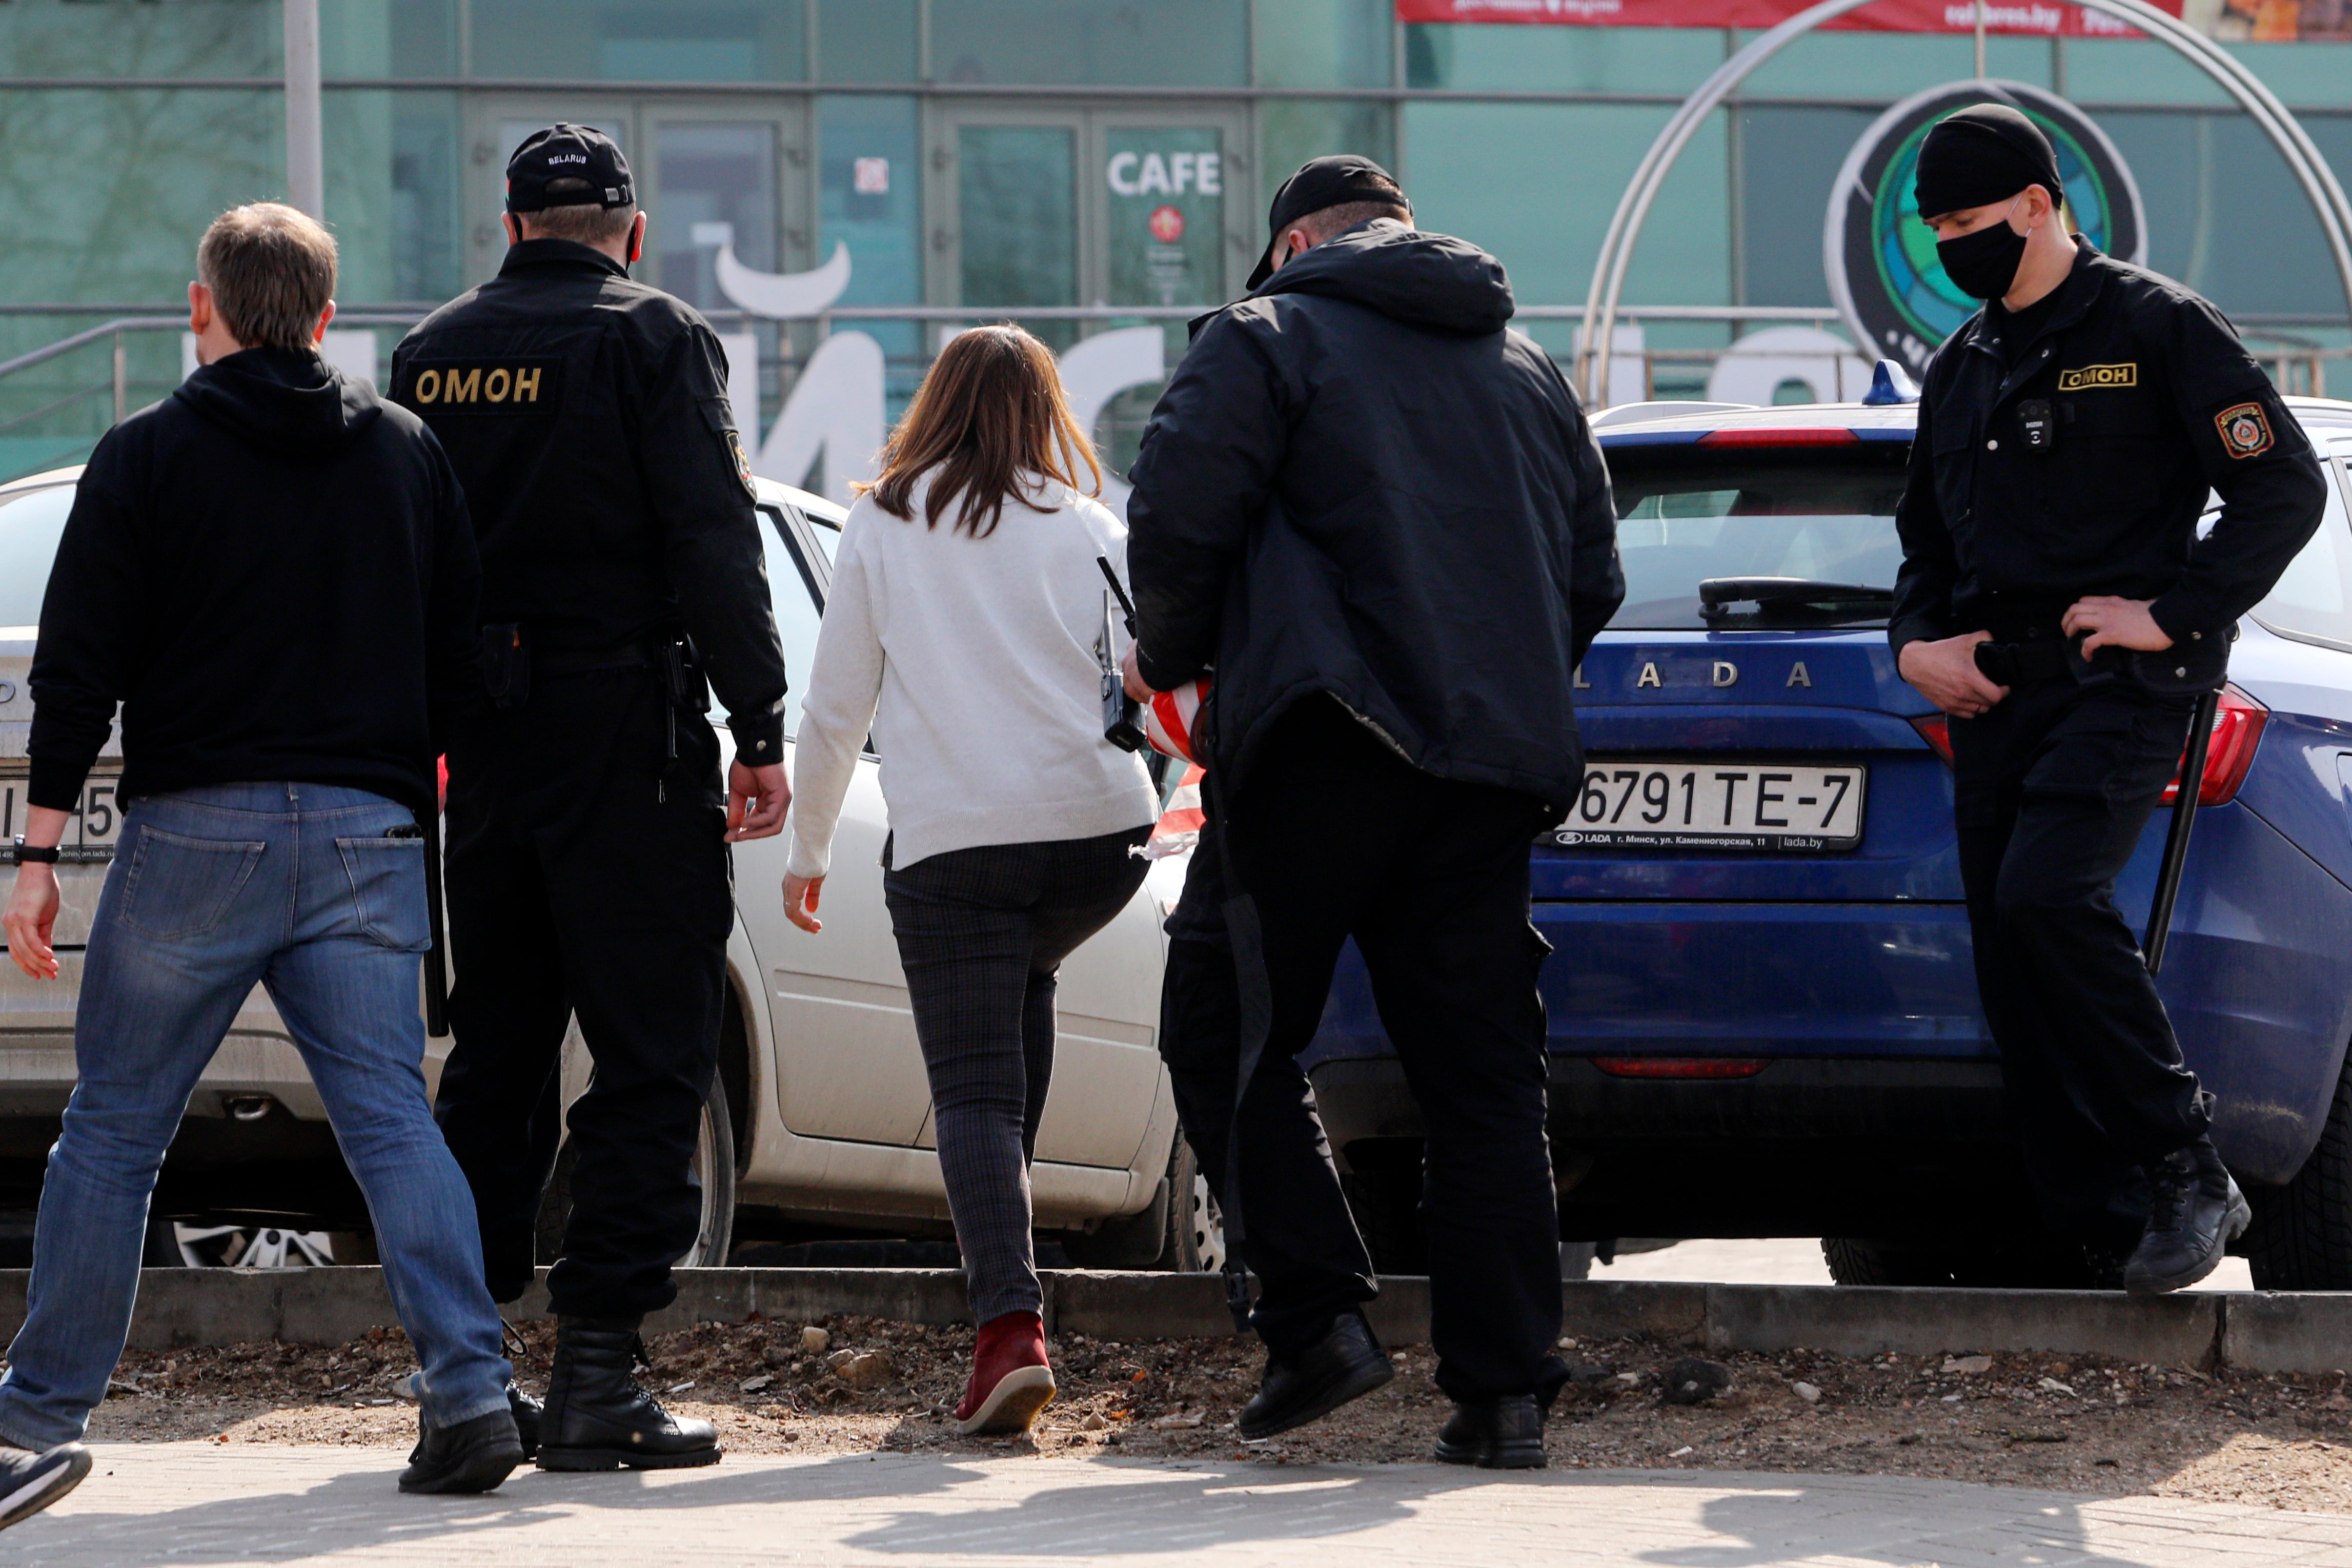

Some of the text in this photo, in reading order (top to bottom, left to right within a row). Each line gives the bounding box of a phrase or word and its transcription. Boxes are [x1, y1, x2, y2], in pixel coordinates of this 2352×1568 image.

[549, 154, 586, 165] BELARUS
[1107, 152, 1222, 197] CAFE
[415, 368, 542, 404] ОМОН
[2069, 368, 2128, 386] ОМОН
[1573, 662, 1811, 688] LADA
[1580, 770, 1695, 824] 6791
[1585, 834, 1611, 843] LADA
[1626, 835, 1657, 845] Минск,
[1660, 837, 1673, 845] ул.
[1675, 836, 1753, 846] Каменногорская,
[1784, 837, 1823, 849] lada.by
